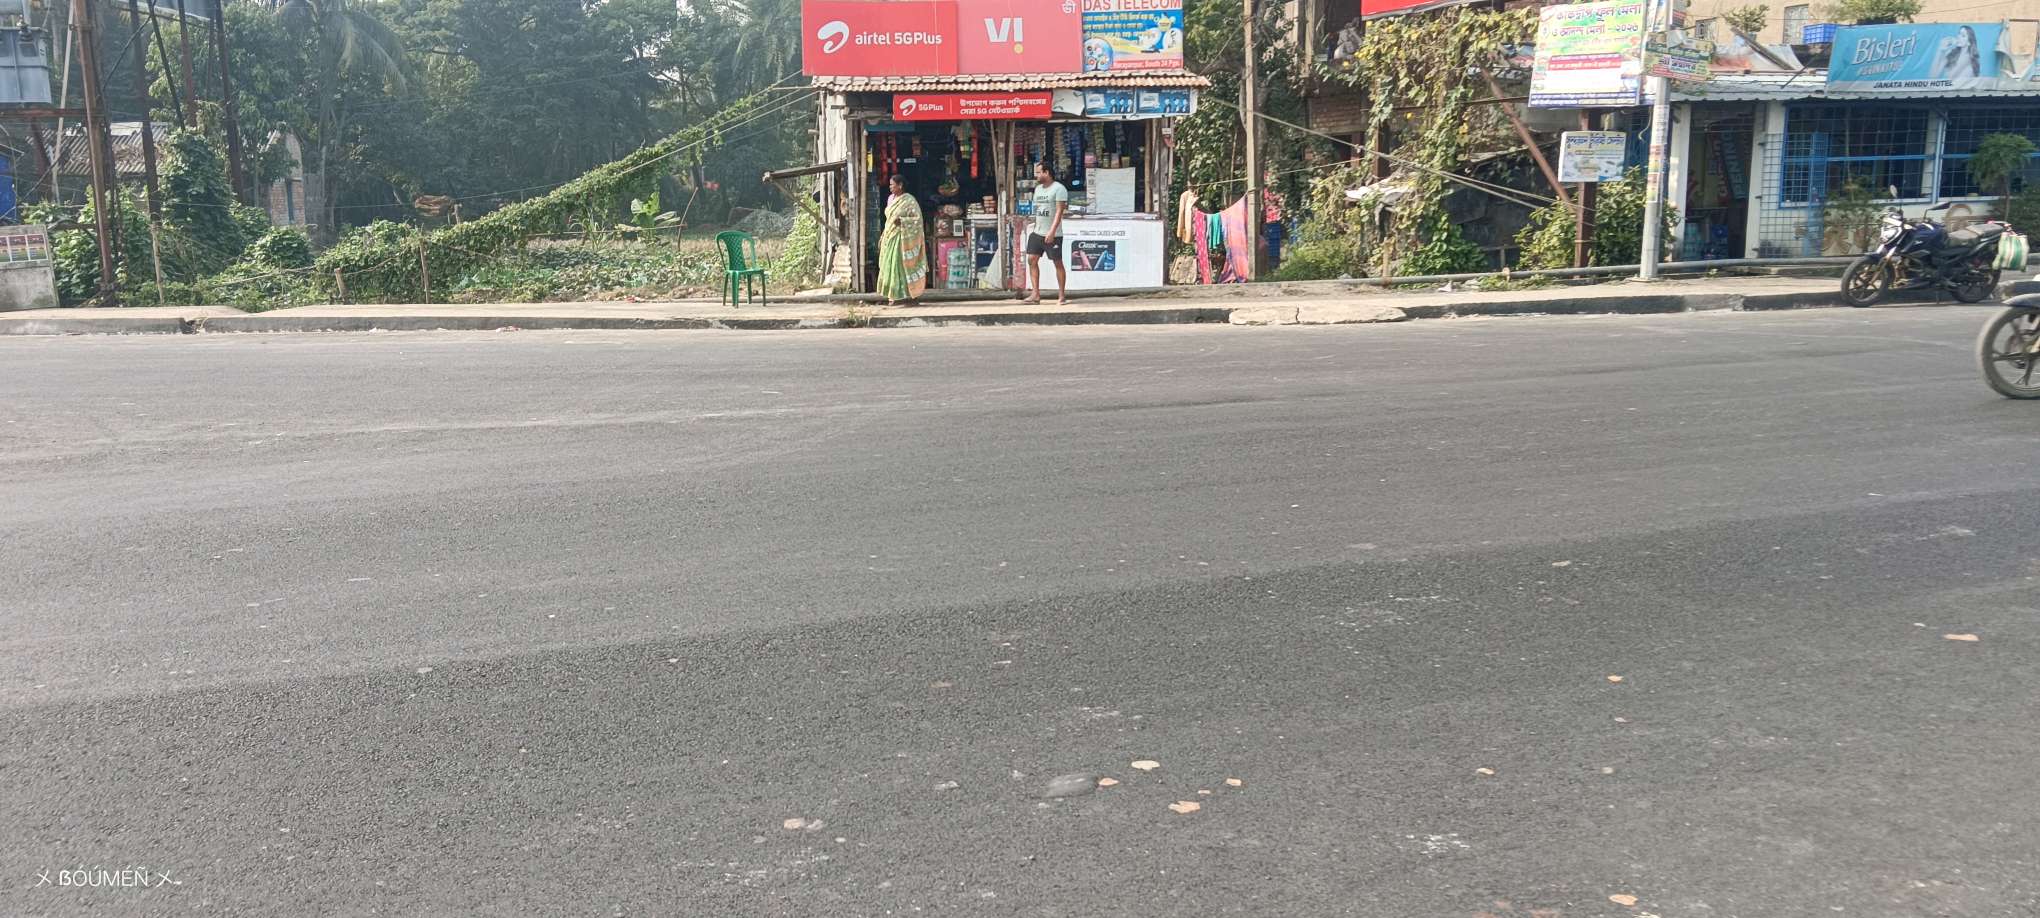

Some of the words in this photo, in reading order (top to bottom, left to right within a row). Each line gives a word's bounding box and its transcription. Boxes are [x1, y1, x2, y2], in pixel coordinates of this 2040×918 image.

[1083, 0, 1110, 11] DAS
[1117, 0, 1181, 10] TELECOM
[1617, 4, 1641, 16] মেলা
[854, 31, 891, 46] airtel
[1851, 31, 1917, 66] Bisleri
[1873, 81, 1902, 89] JANATA
[1930, 80, 1953, 88] HOTEL
[977, 107, 987, 115] 5G
